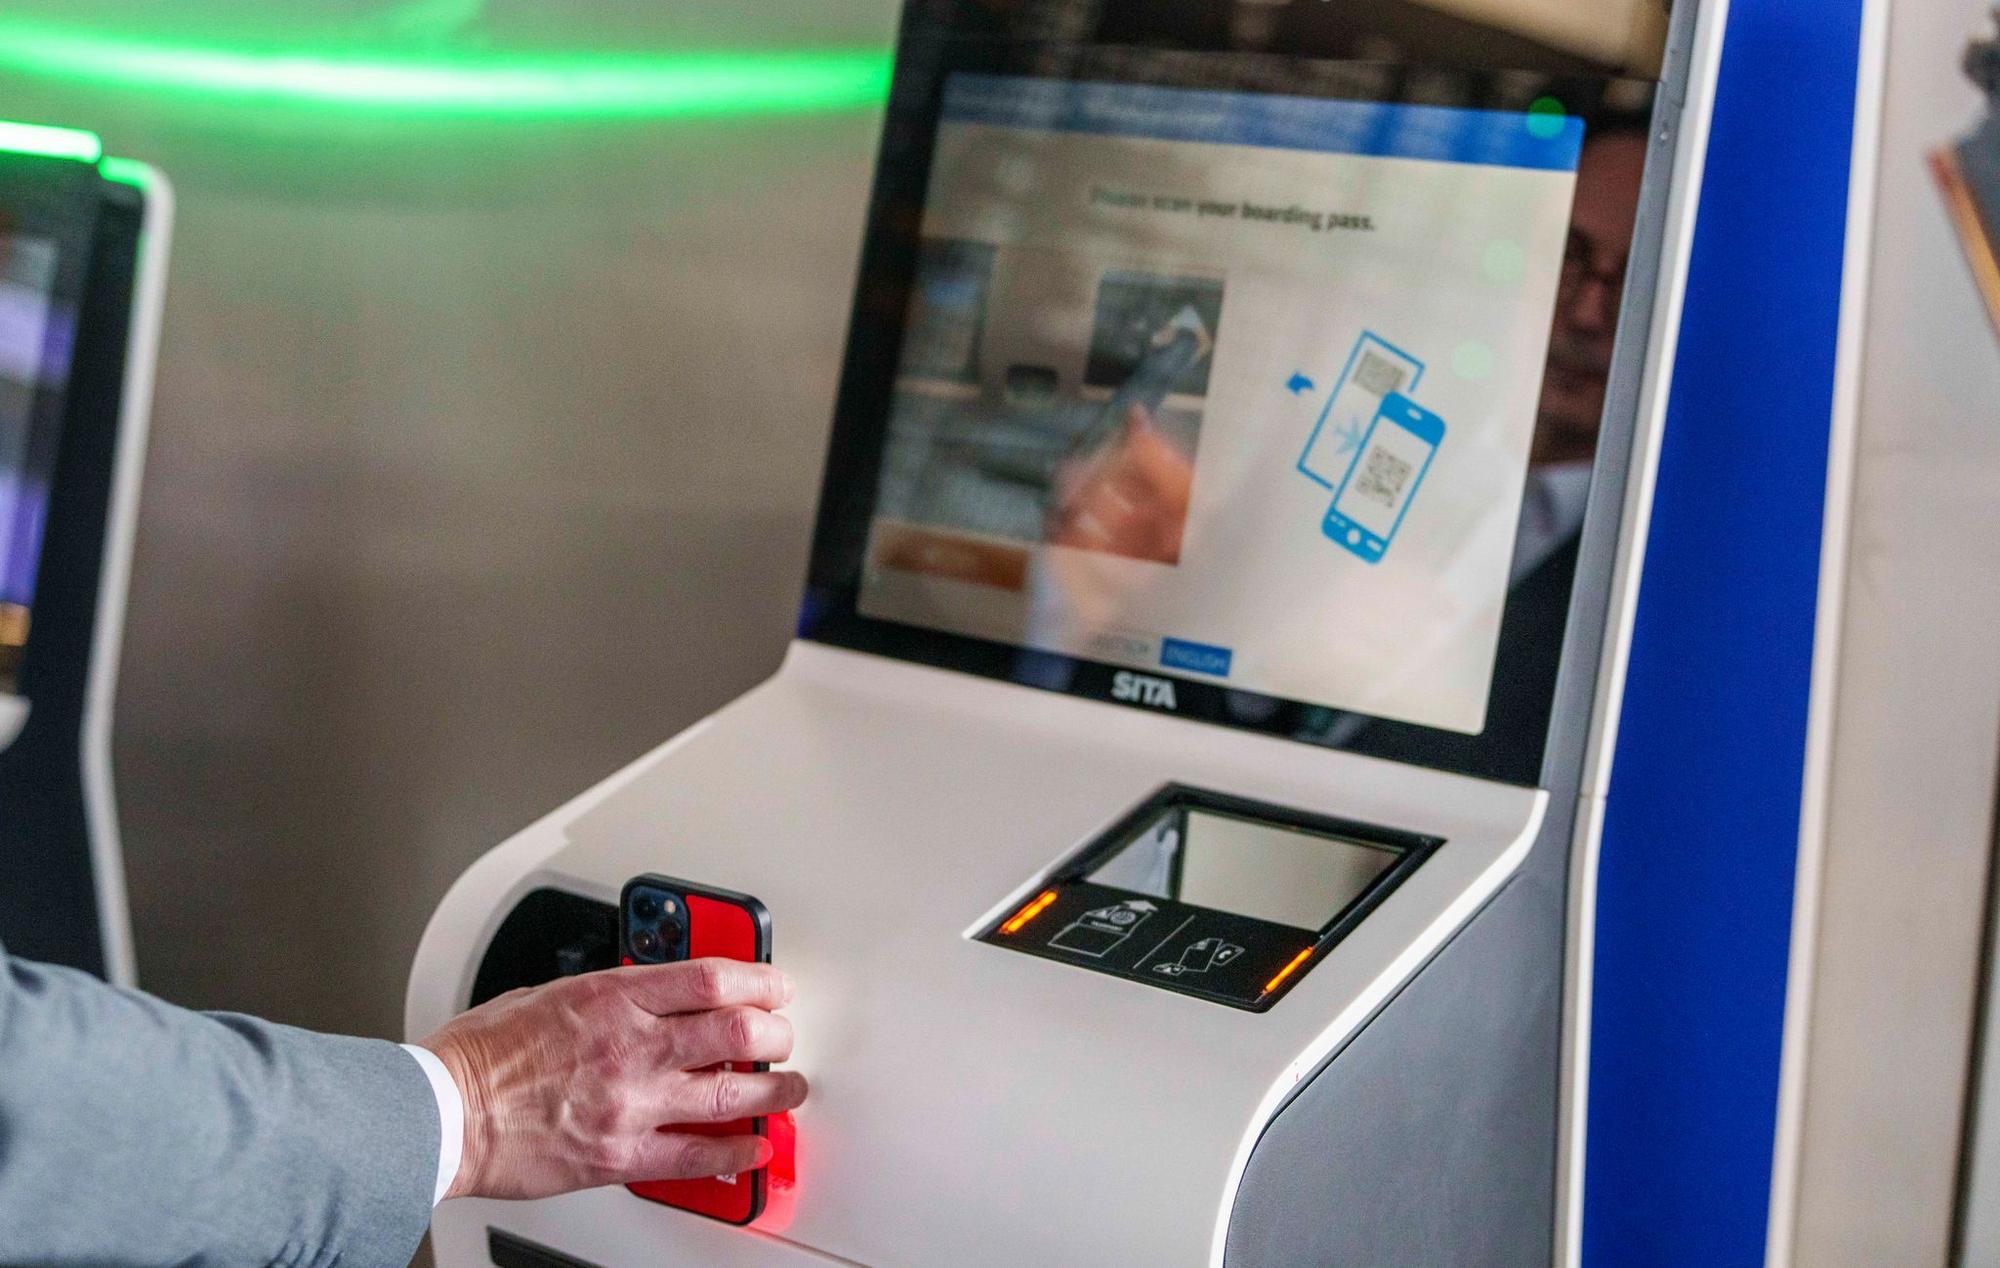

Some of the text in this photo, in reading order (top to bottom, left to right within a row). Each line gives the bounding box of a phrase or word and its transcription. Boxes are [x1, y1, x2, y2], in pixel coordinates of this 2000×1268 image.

[1197, 201, 1236, 218] your
[1242, 202, 1325, 232] boarding
[1327, 212, 1377, 232] pass.
[1111, 671, 1177, 709] SITA
